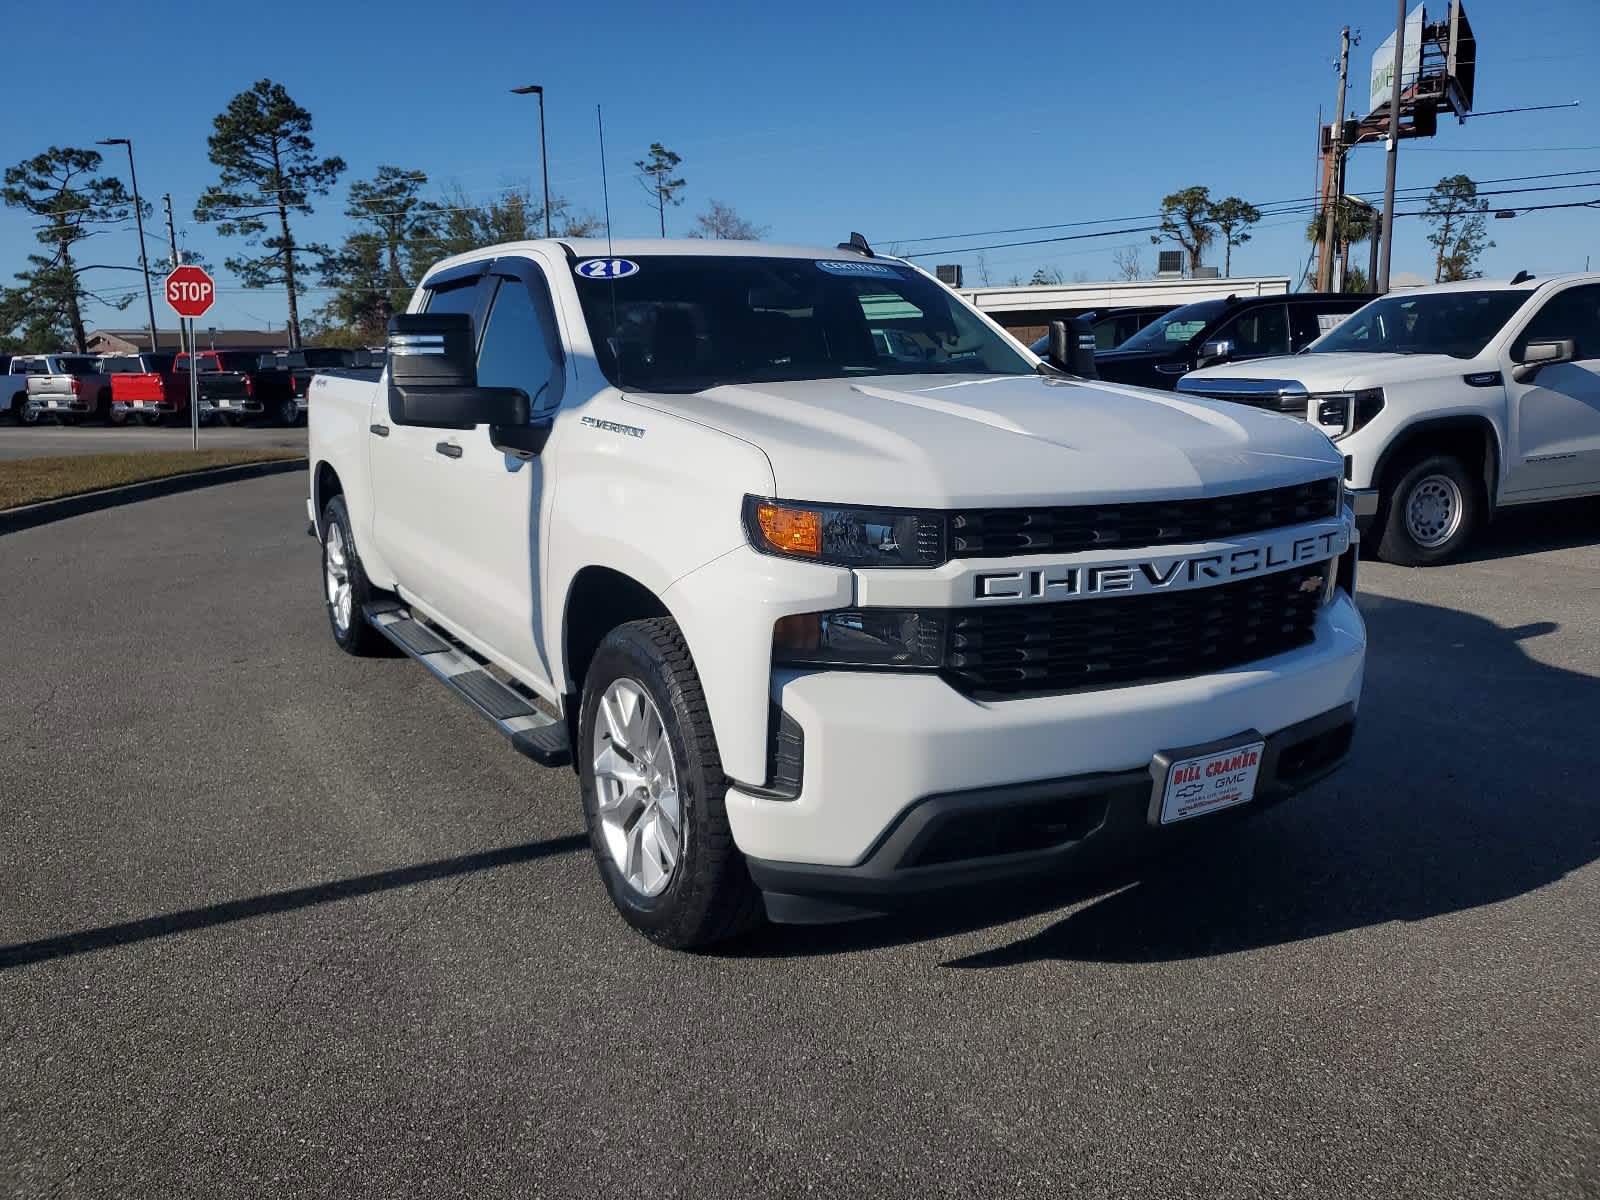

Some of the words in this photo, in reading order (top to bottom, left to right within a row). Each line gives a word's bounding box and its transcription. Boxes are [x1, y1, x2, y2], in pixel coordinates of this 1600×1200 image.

[590, 260, 621, 276] 21
[169, 281, 211, 302] STOP
[975, 531, 1338, 599] CHEVROLET
[1174, 765, 1201, 785] BILL
[1205, 751, 1258, 778] CRAMER
[1215, 771, 1247, 789] GMC
